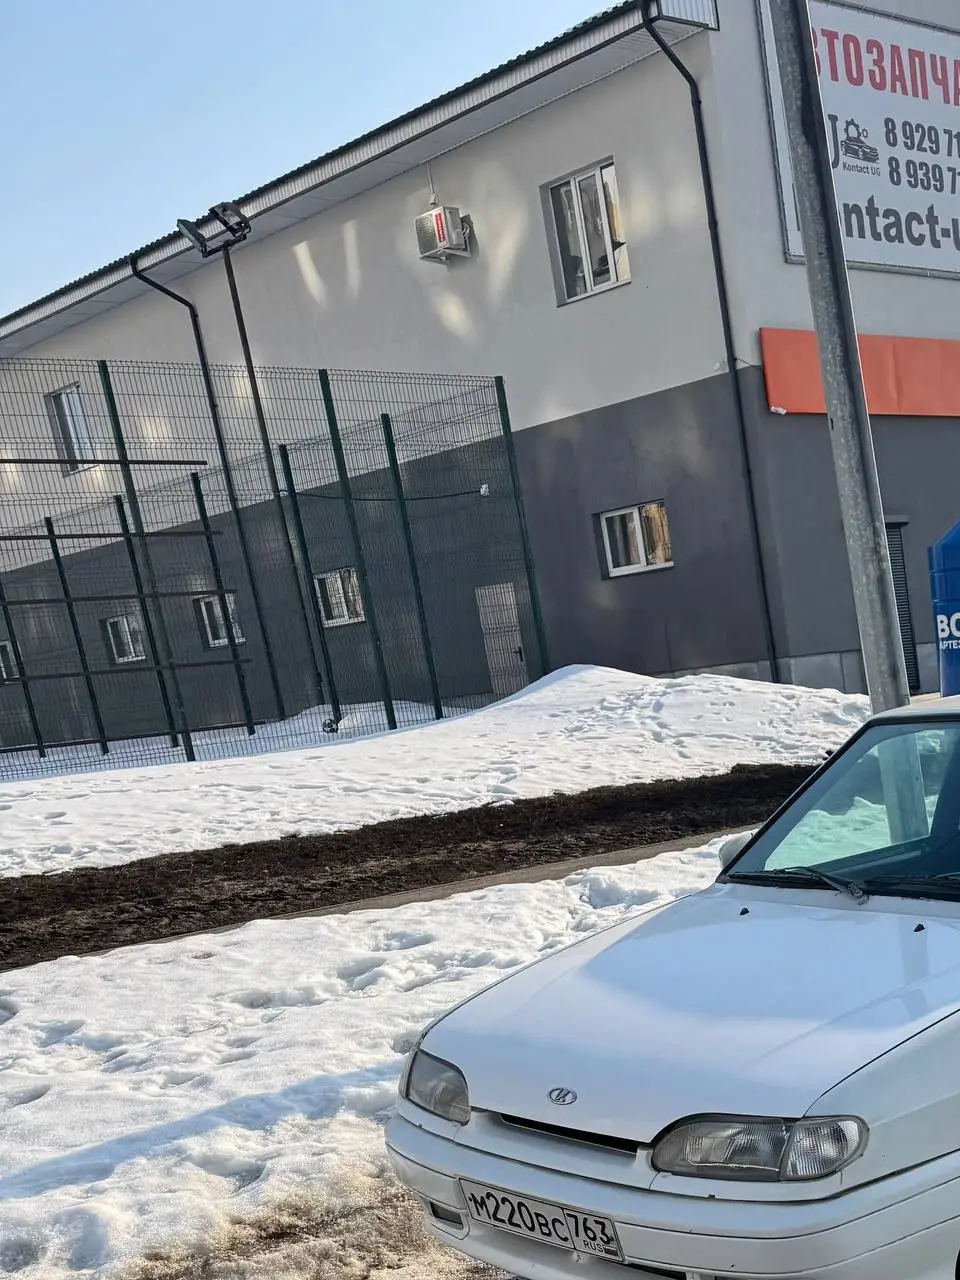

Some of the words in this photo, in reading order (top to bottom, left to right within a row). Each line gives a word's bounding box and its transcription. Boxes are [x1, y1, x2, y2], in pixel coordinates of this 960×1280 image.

[884, 117, 898, 147] 8
[902, 120, 941, 155] 929
[842, 161, 870, 175] Kontact
[888, 156, 902, 186] 8
[905, 159, 945, 193] 939
[565, 1212, 612, 1245] 763
[582, 1239, 604, 1253] RUS
